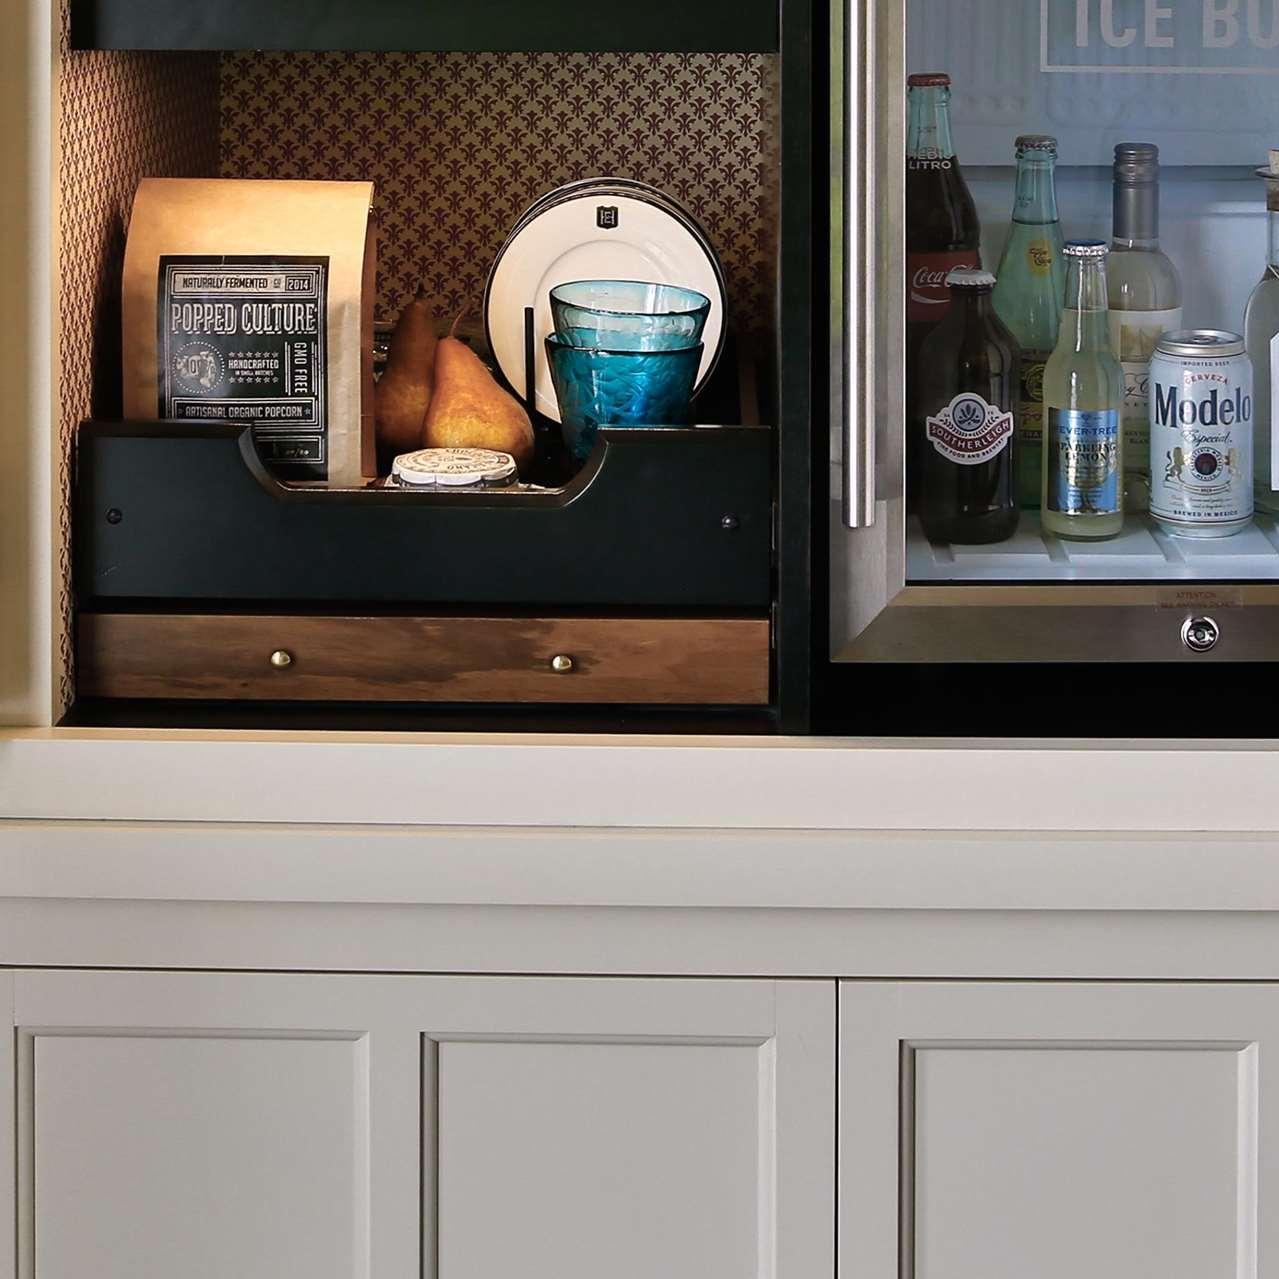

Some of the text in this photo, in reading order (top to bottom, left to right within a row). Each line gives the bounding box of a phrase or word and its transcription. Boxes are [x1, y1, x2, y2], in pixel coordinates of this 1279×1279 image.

[909, 160, 952, 170] LITRO
[182, 277, 310, 291] NATURALLY FERMENTED 2014
[171, 302, 318, 335] POPPED CULTURE
[228, 359, 280, 370] HANDCRAFTED
[293, 342, 309, 394] GMO FREE
[1184, 372, 1230, 386] CERVEZA
[185, 405, 303, 418] ARTISANAL ORGANIC POPCORN
[1154, 382, 1251, 429] Modelo
[930, 421, 1010, 450] SOUTHERLEIGH
[949, 438, 1005, 459] FOOD AND BREWERY
[1173, 509, 1202, 518] BREWED
[1214, 509, 1238, 517] MEXICO
